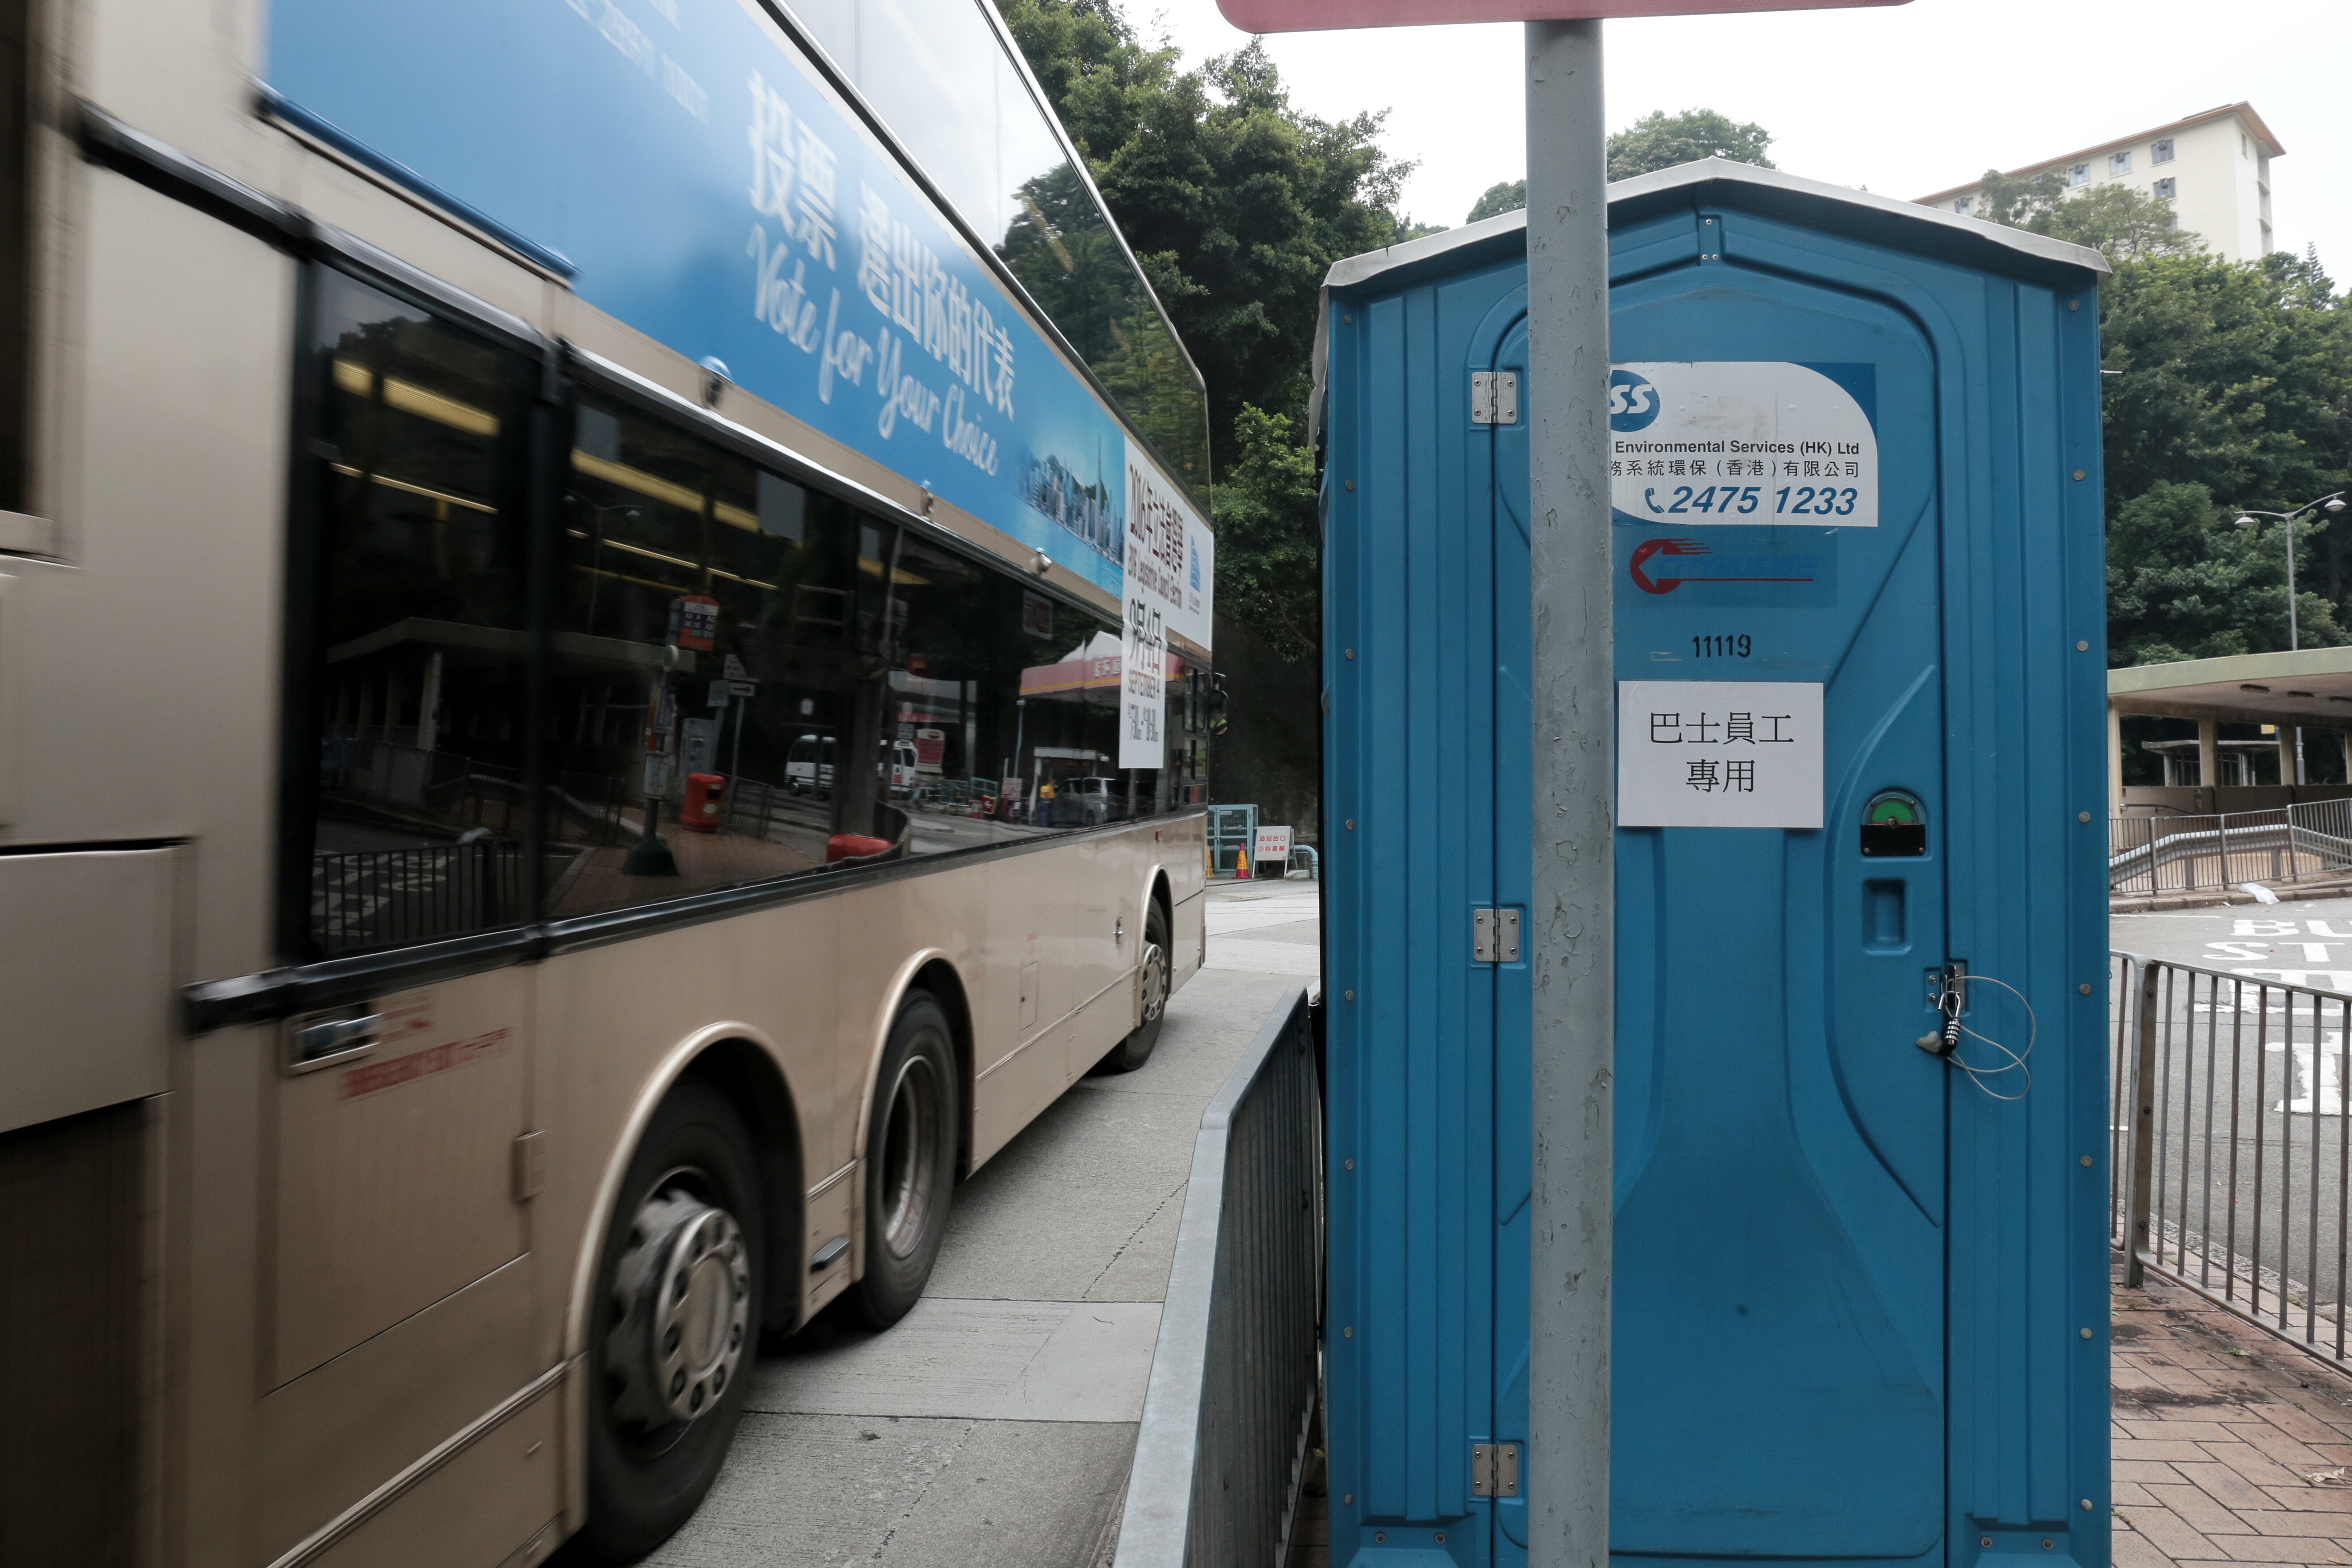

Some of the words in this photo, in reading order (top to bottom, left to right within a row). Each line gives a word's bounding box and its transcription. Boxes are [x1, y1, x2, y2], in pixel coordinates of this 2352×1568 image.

[747, 66, 837, 273] 投票
[746, 223, 821, 354] Vote
[819, 287, 873, 405] for
[877, 326, 941, 440] Your
[943, 383, 999, 476] Choice
[1615, 440, 1725, 453] Environmental
[1730, 440, 1795, 453] Services
[1800, 441, 1832, 456] (HK)
[1838, 442, 1859, 455] Ltd
[1668, 486, 1761, 514] 2475
[1776, 486, 1857, 515] 1233
[1692, 634, 1751, 658] 11119
[1649, 712, 1794, 745] 巴士員工
[1686, 759, 1755, 793] 專用
[2202, 941, 2345, 962] ST
